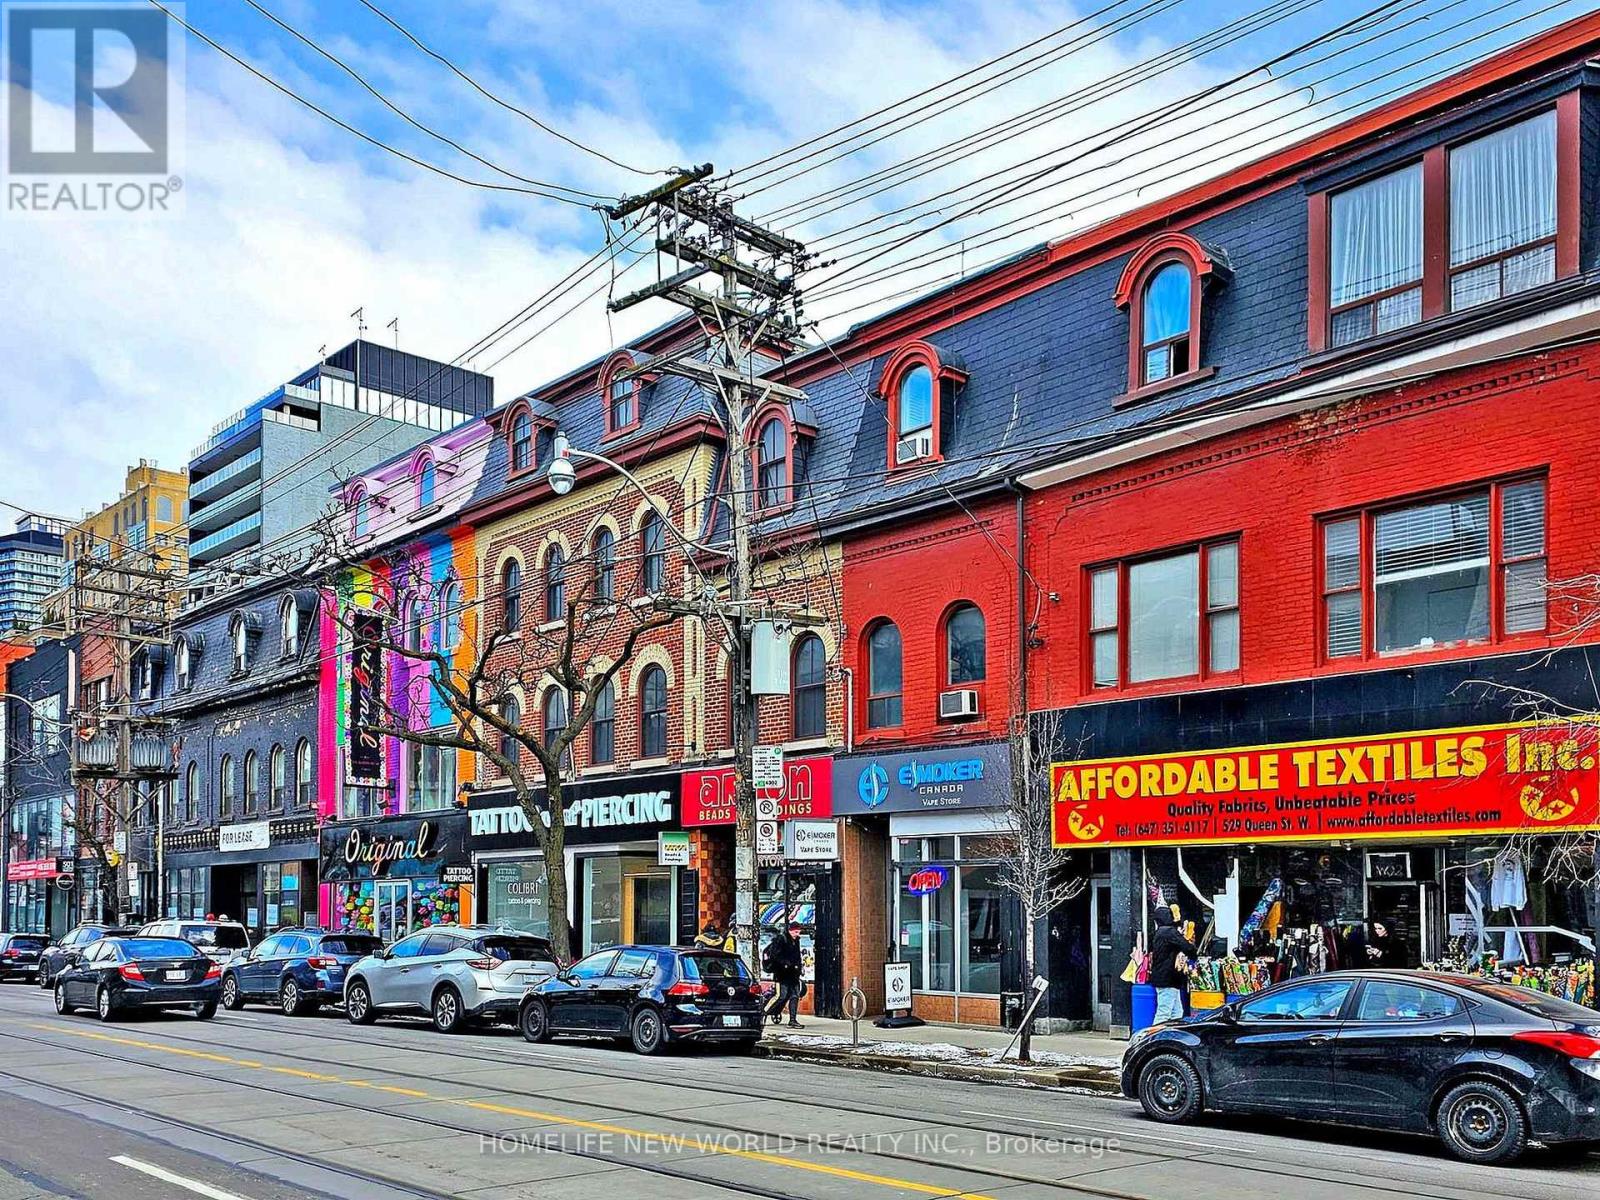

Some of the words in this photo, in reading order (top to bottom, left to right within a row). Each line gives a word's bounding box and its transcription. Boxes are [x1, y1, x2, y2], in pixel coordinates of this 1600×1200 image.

[1292, 736, 1488, 788] TEXTILES
[1506, 733, 1596, 774] Inc.
[919, 784, 964, 795] CANADA
[1057, 754, 1280, 803] AFFORDABLE
[581, 791, 671, 828] PIERCING
[699, 809, 731, 820] BEADS
[776, 802, 812, 815] DINGS
[1167, 800, 1214, 817] Quality
[1218, 798, 1270, 814] Fabrics,
[1274, 791, 1362, 811] Unbeatable
[1367, 789, 1416, 805] Prices
[1135, 822, 1159, 836] (647)
[1223, 818, 1242, 833] 529
[1245, 818, 1278, 832] Queen
[1281, 816, 1294, 830] St.
[1299, 815, 1312, 829] W.
[1327, 808, 1501, 828] www.affordabletextiles.com
[222, 833, 234, 844] FOR
[235, 831, 253, 844] LEASE
[345, 821, 429, 875] Original
[446, 867, 472, 875] TATTOO
[908, 871, 942, 890] OPEN
[507, 882, 538, 894] COLIBRI
